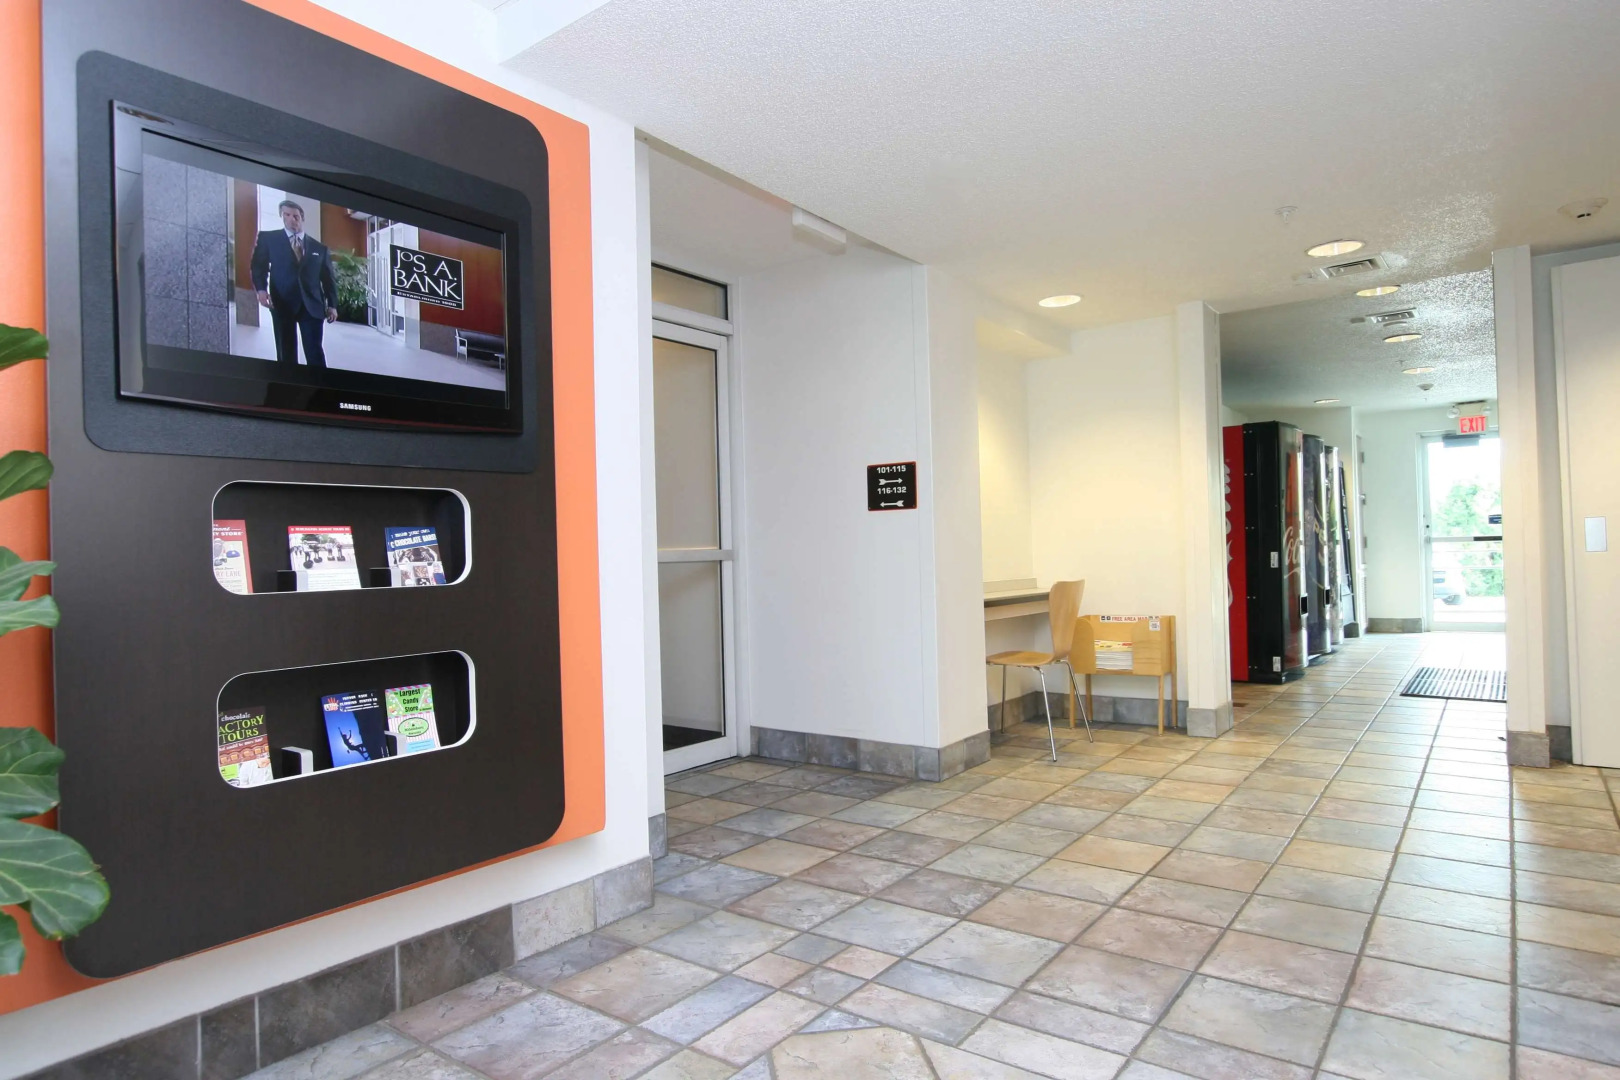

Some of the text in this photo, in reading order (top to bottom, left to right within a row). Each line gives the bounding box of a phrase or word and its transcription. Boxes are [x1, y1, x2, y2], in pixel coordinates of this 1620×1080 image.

[433, 260, 458, 281] A.
[393, 268, 461, 300] BANK
[339, 402, 371, 411] SAMSUNG
[1459, 416, 1485, 433] EXIT
[876, 465, 906, 474] 101-115
[877, 486, 907, 495] 116-132
[394, 535, 423, 547] CHOCOLATE
[399, 688, 421, 697] Largest
[402, 697, 419, 705] Candy
[219, 715, 264, 733] ACTORY
[219, 728, 259, 744] TOURS
